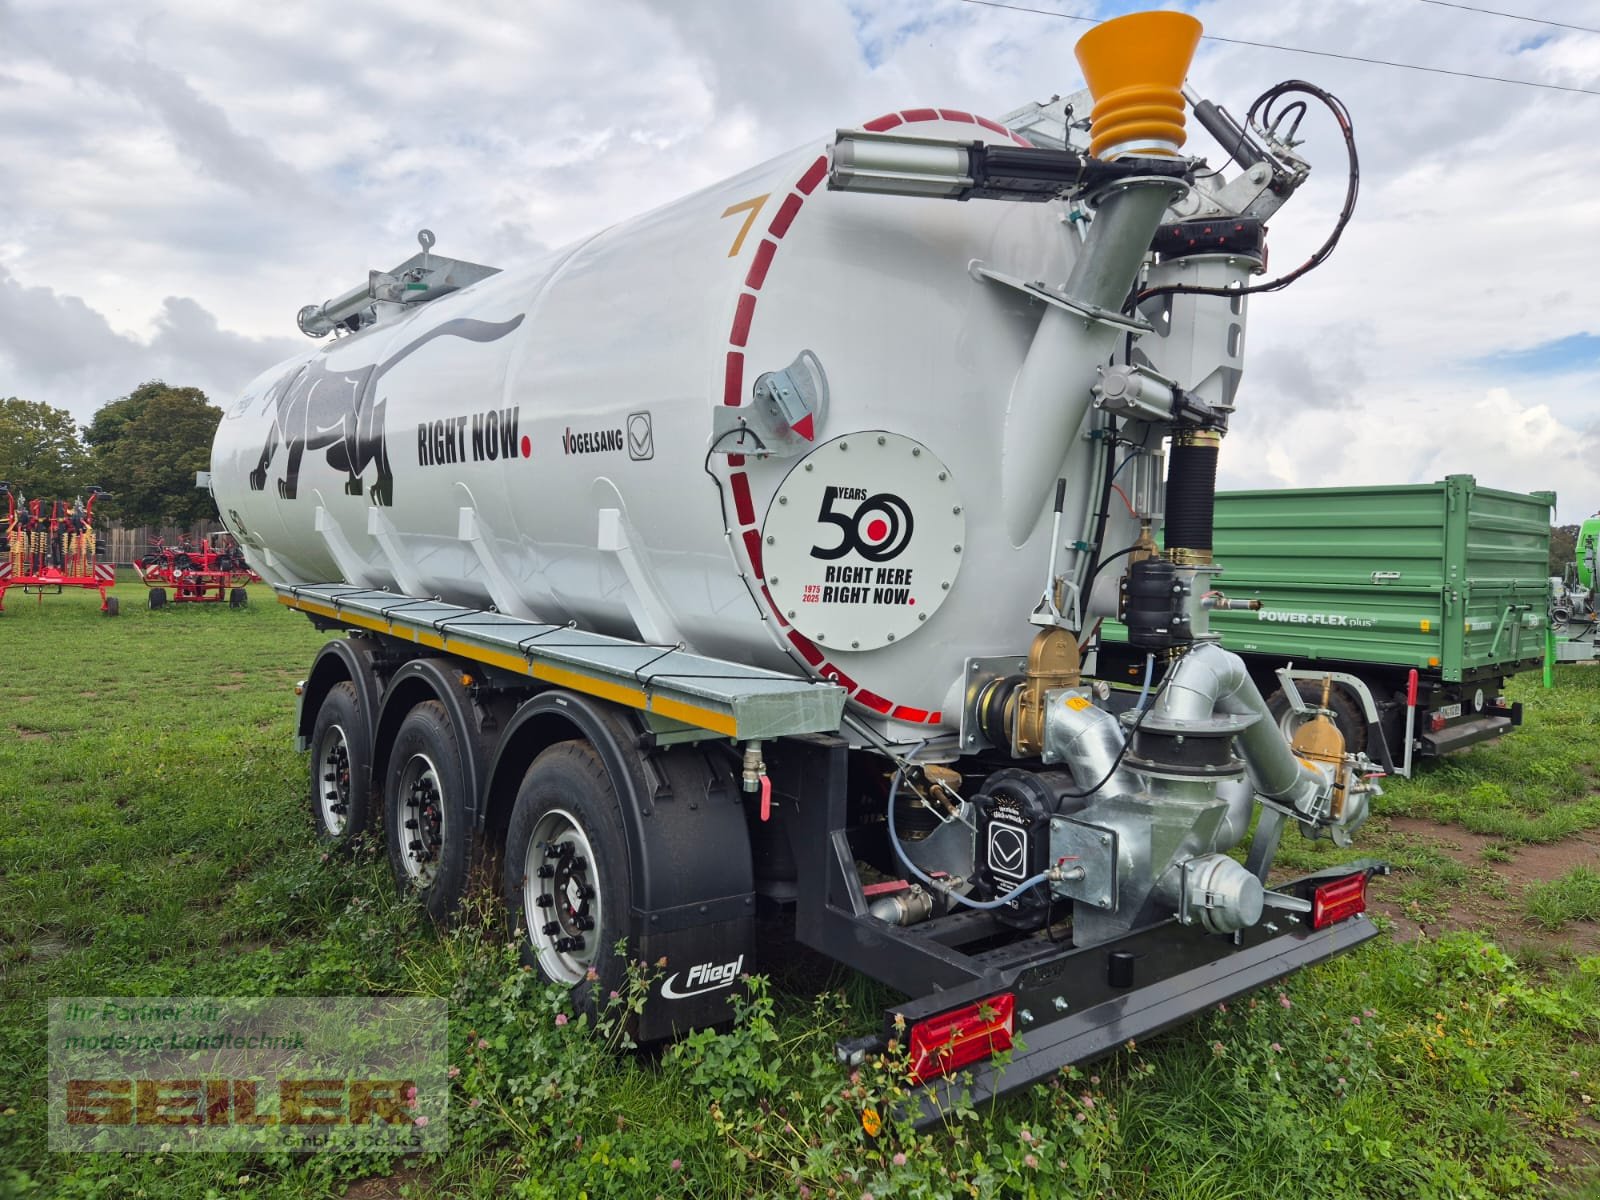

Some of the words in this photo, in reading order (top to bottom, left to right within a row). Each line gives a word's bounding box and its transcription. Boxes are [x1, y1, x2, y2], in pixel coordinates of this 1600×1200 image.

[418, 416, 467, 467] RIGHT
[562, 427, 623, 455] VOGELSANG
[837, 486, 867, 501] YEARS
[809, 485, 914, 562] 50
[825, 566, 873, 584] RIGHT
[875, 568, 913, 586] HERE
[802, 594, 820, 603] 2025
[803, 585, 821, 594] 1975
[822, 586, 871, 604] RIGHT
[1258, 610, 1348, 626] POWER-FLEX
[686, 954, 744, 988] Fliegl
